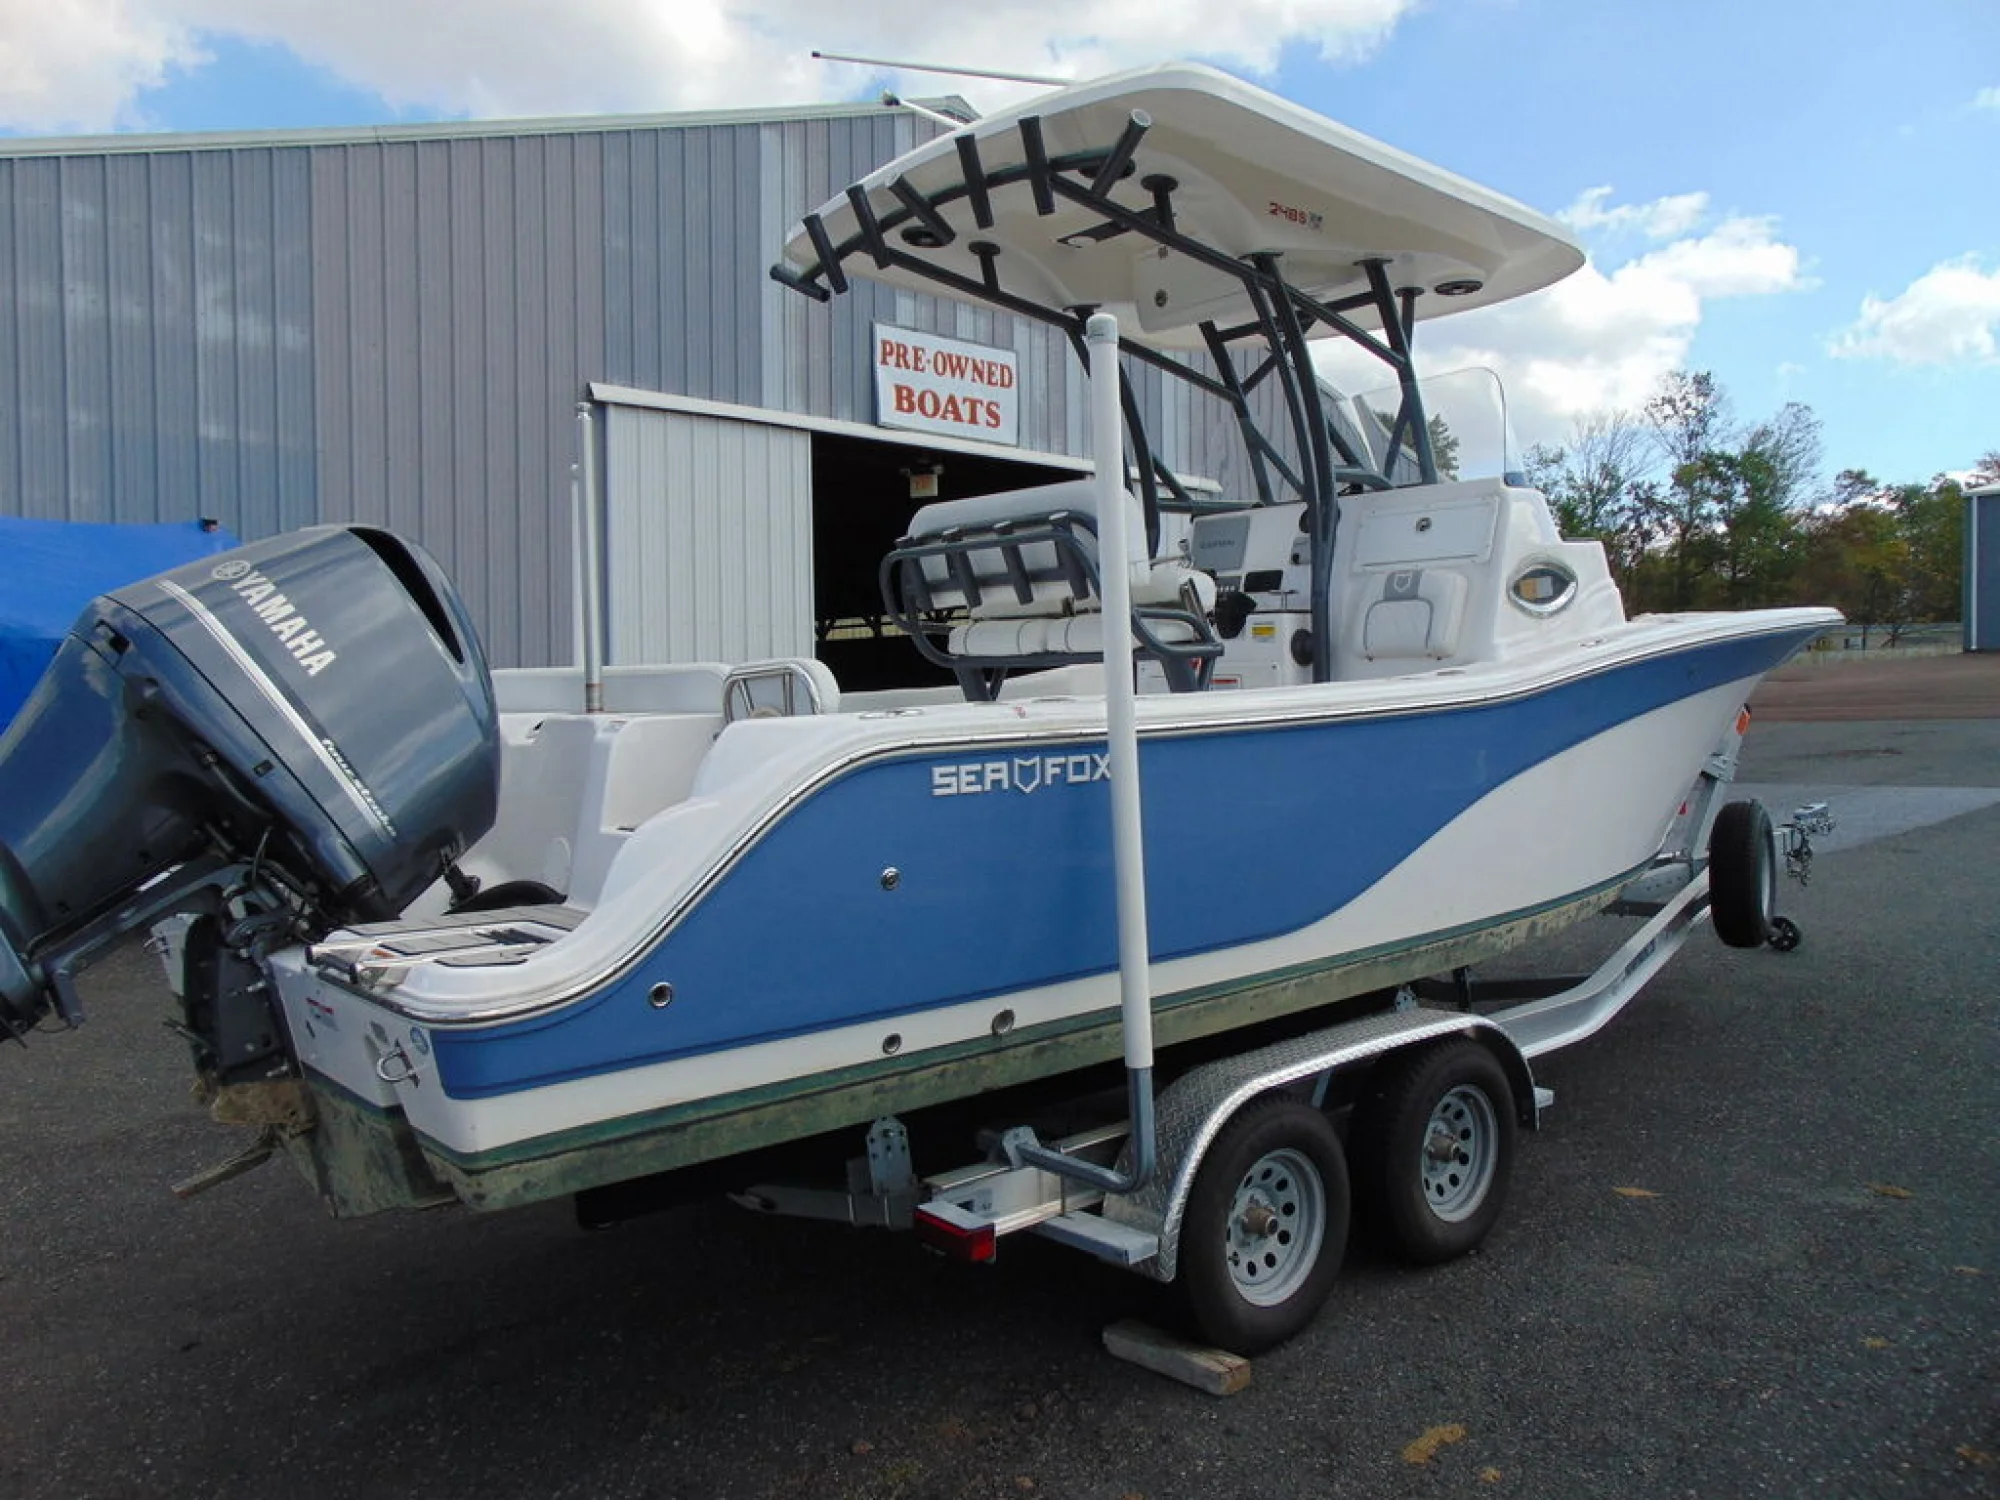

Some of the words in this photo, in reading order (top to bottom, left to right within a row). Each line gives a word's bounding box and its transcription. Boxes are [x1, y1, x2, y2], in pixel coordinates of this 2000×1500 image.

[880, 339, 1013, 389] PRE-OWNED
[894, 384, 1001, 428] BOATS
[231, 570, 336, 676] YAMAHA
[931, 761, 1009, 796] SEA
[1044, 753, 1111, 785] FOX
